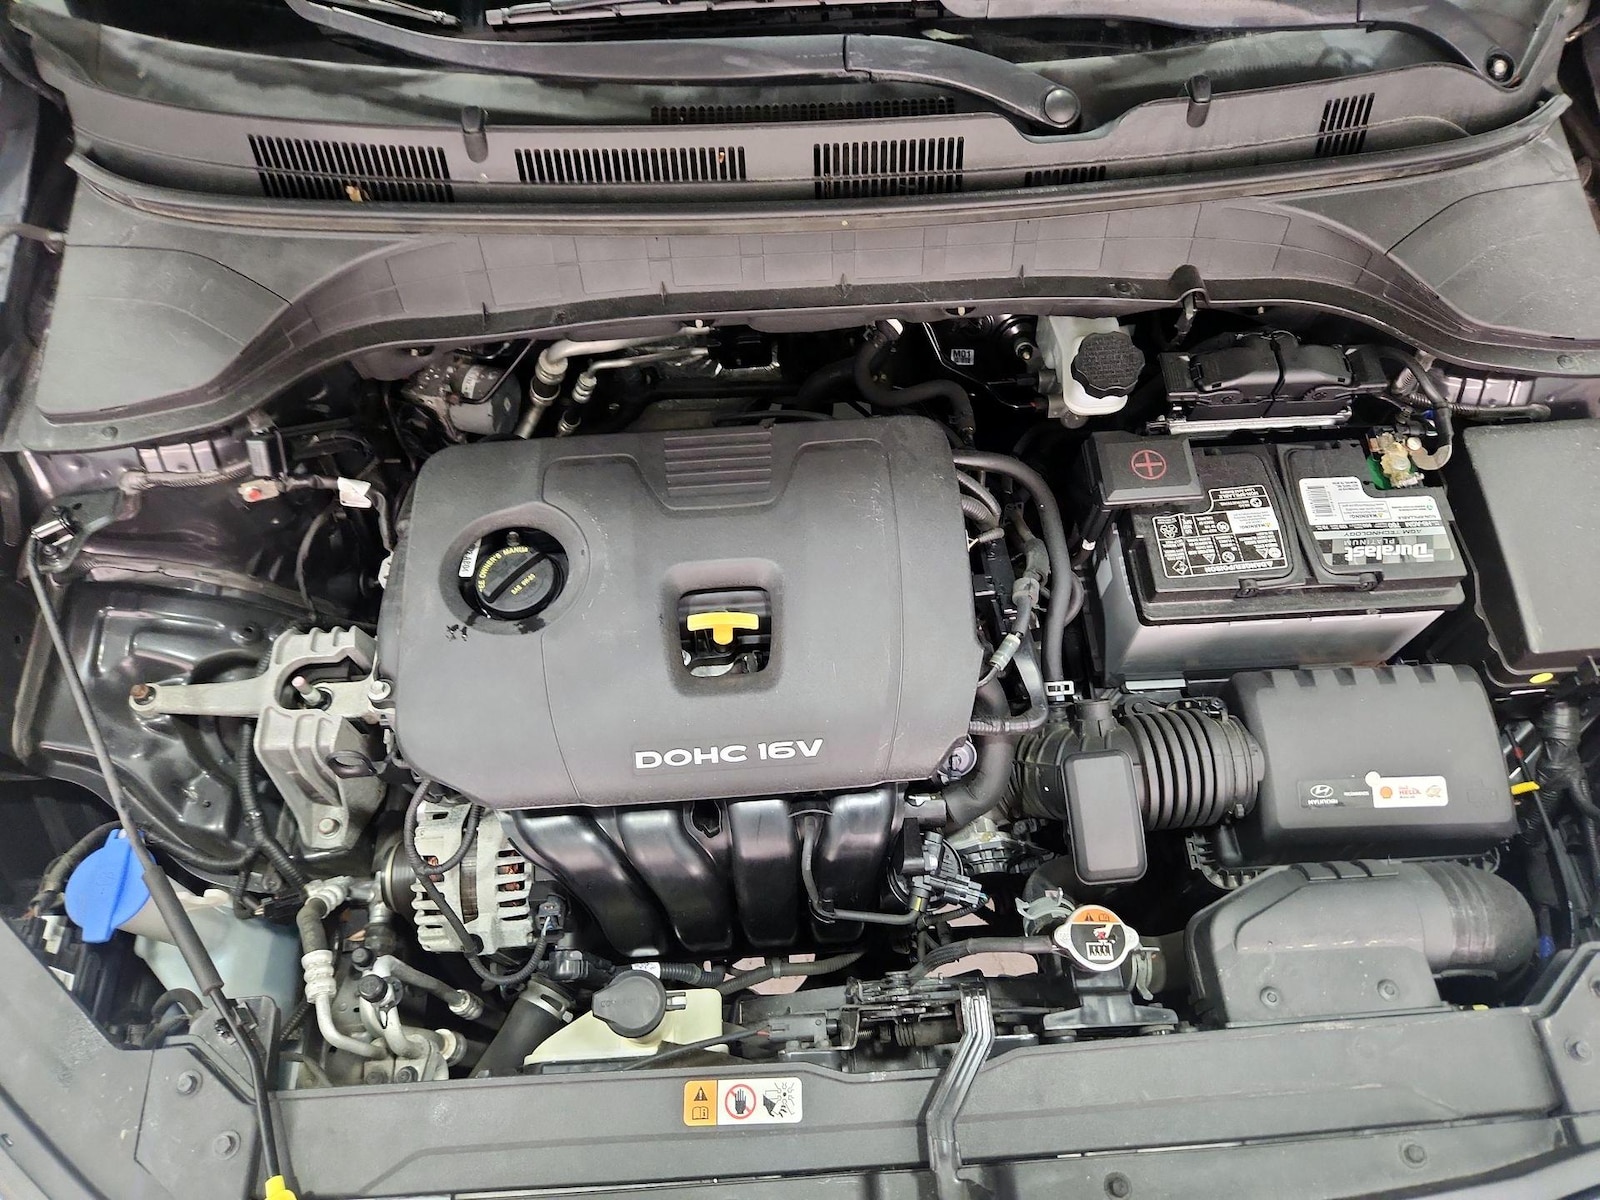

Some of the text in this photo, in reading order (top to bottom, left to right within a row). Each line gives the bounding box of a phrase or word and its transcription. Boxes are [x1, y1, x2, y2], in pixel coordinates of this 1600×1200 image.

[1344, 538, 1395, 546] PLATINUM
[1344, 543, 1434, 562] Duralast
[634, 738, 824, 769] DOHC 16V
